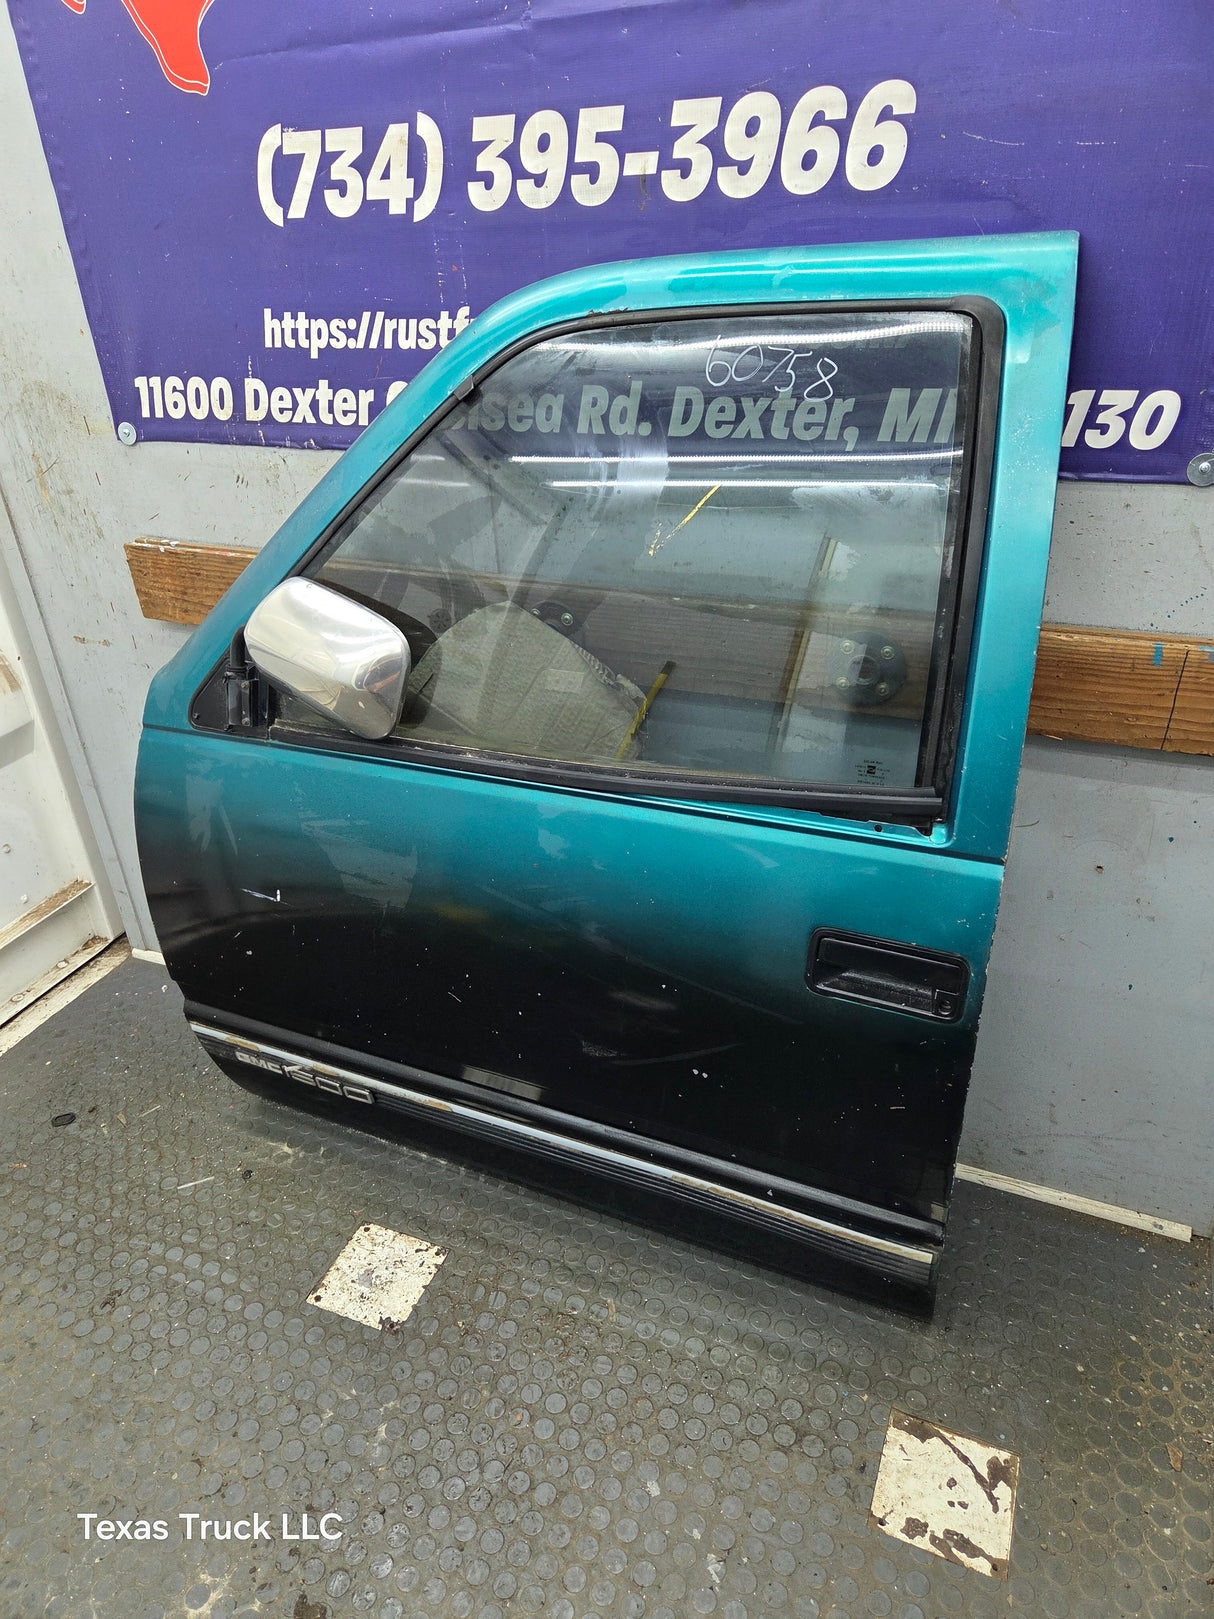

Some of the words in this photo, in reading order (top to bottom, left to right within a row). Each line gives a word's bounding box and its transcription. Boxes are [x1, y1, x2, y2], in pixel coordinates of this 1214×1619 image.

[257, 112, 443, 227] (734)
[467, 79, 917, 213] 395-3966
[263, 306, 475, 359] https://rustf
[135, 376, 234, 421] 11600
[245, 377, 375, 427] Dexter
[577, 380, 651, 436] Rd.
[667, 386, 859, 452] Dexter,
